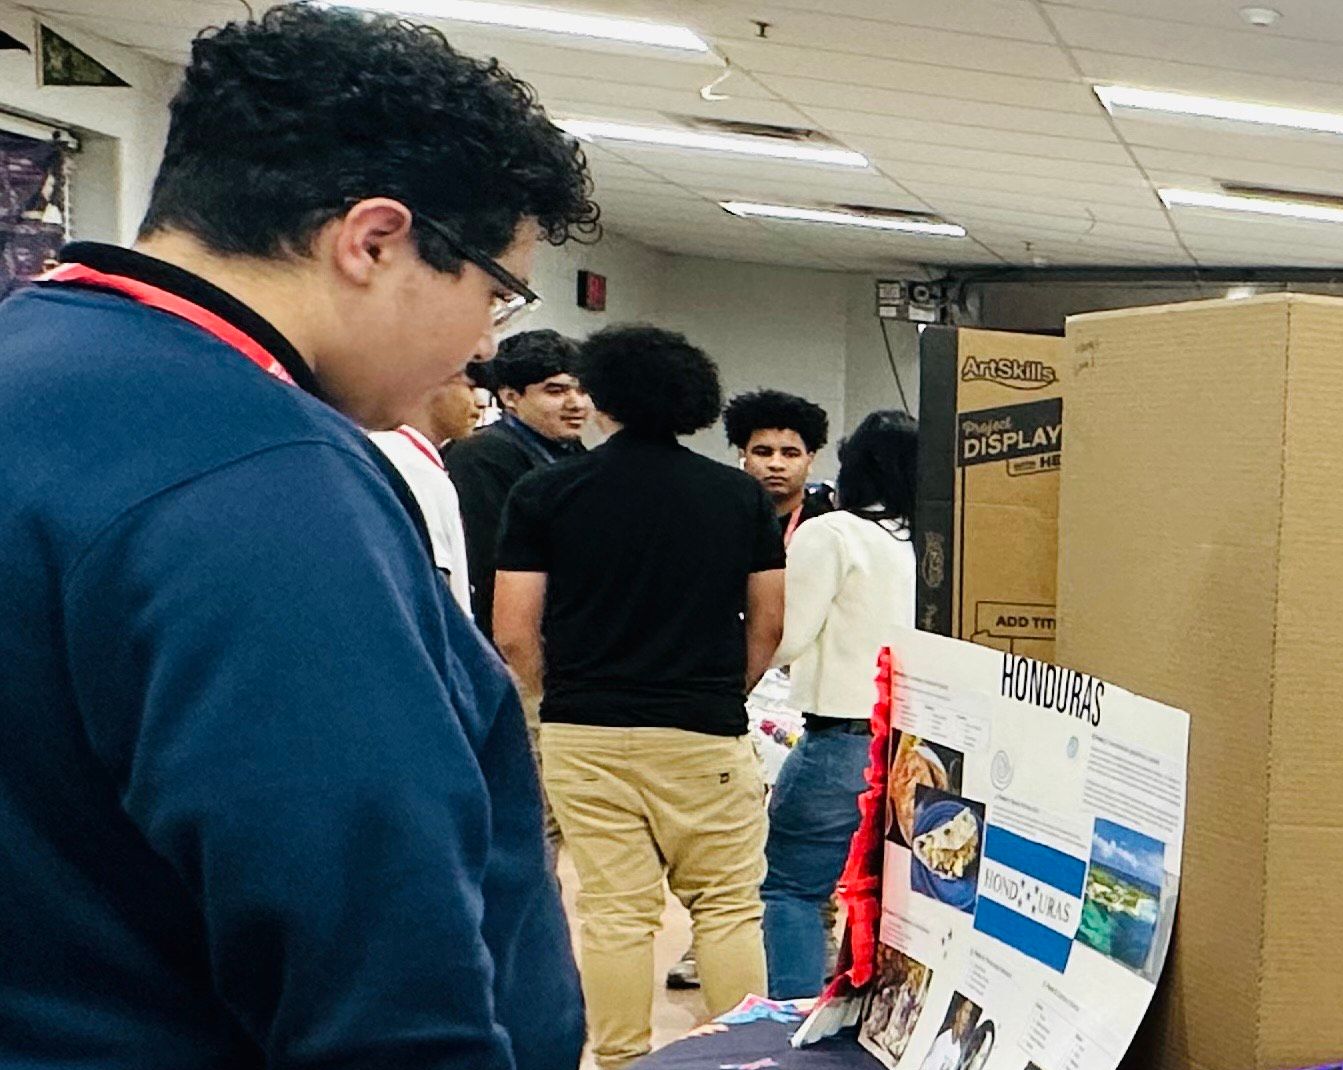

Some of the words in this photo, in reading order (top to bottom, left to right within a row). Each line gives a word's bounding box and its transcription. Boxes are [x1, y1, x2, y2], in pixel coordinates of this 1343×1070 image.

[961, 356, 1056, 381] ArtSkills
[962, 416, 1013, 437] Project
[963, 424, 1062, 459] DISPLAY
[996, 615, 1028, 628] ADD
[1001, 651, 1105, 727] HONDURAS
